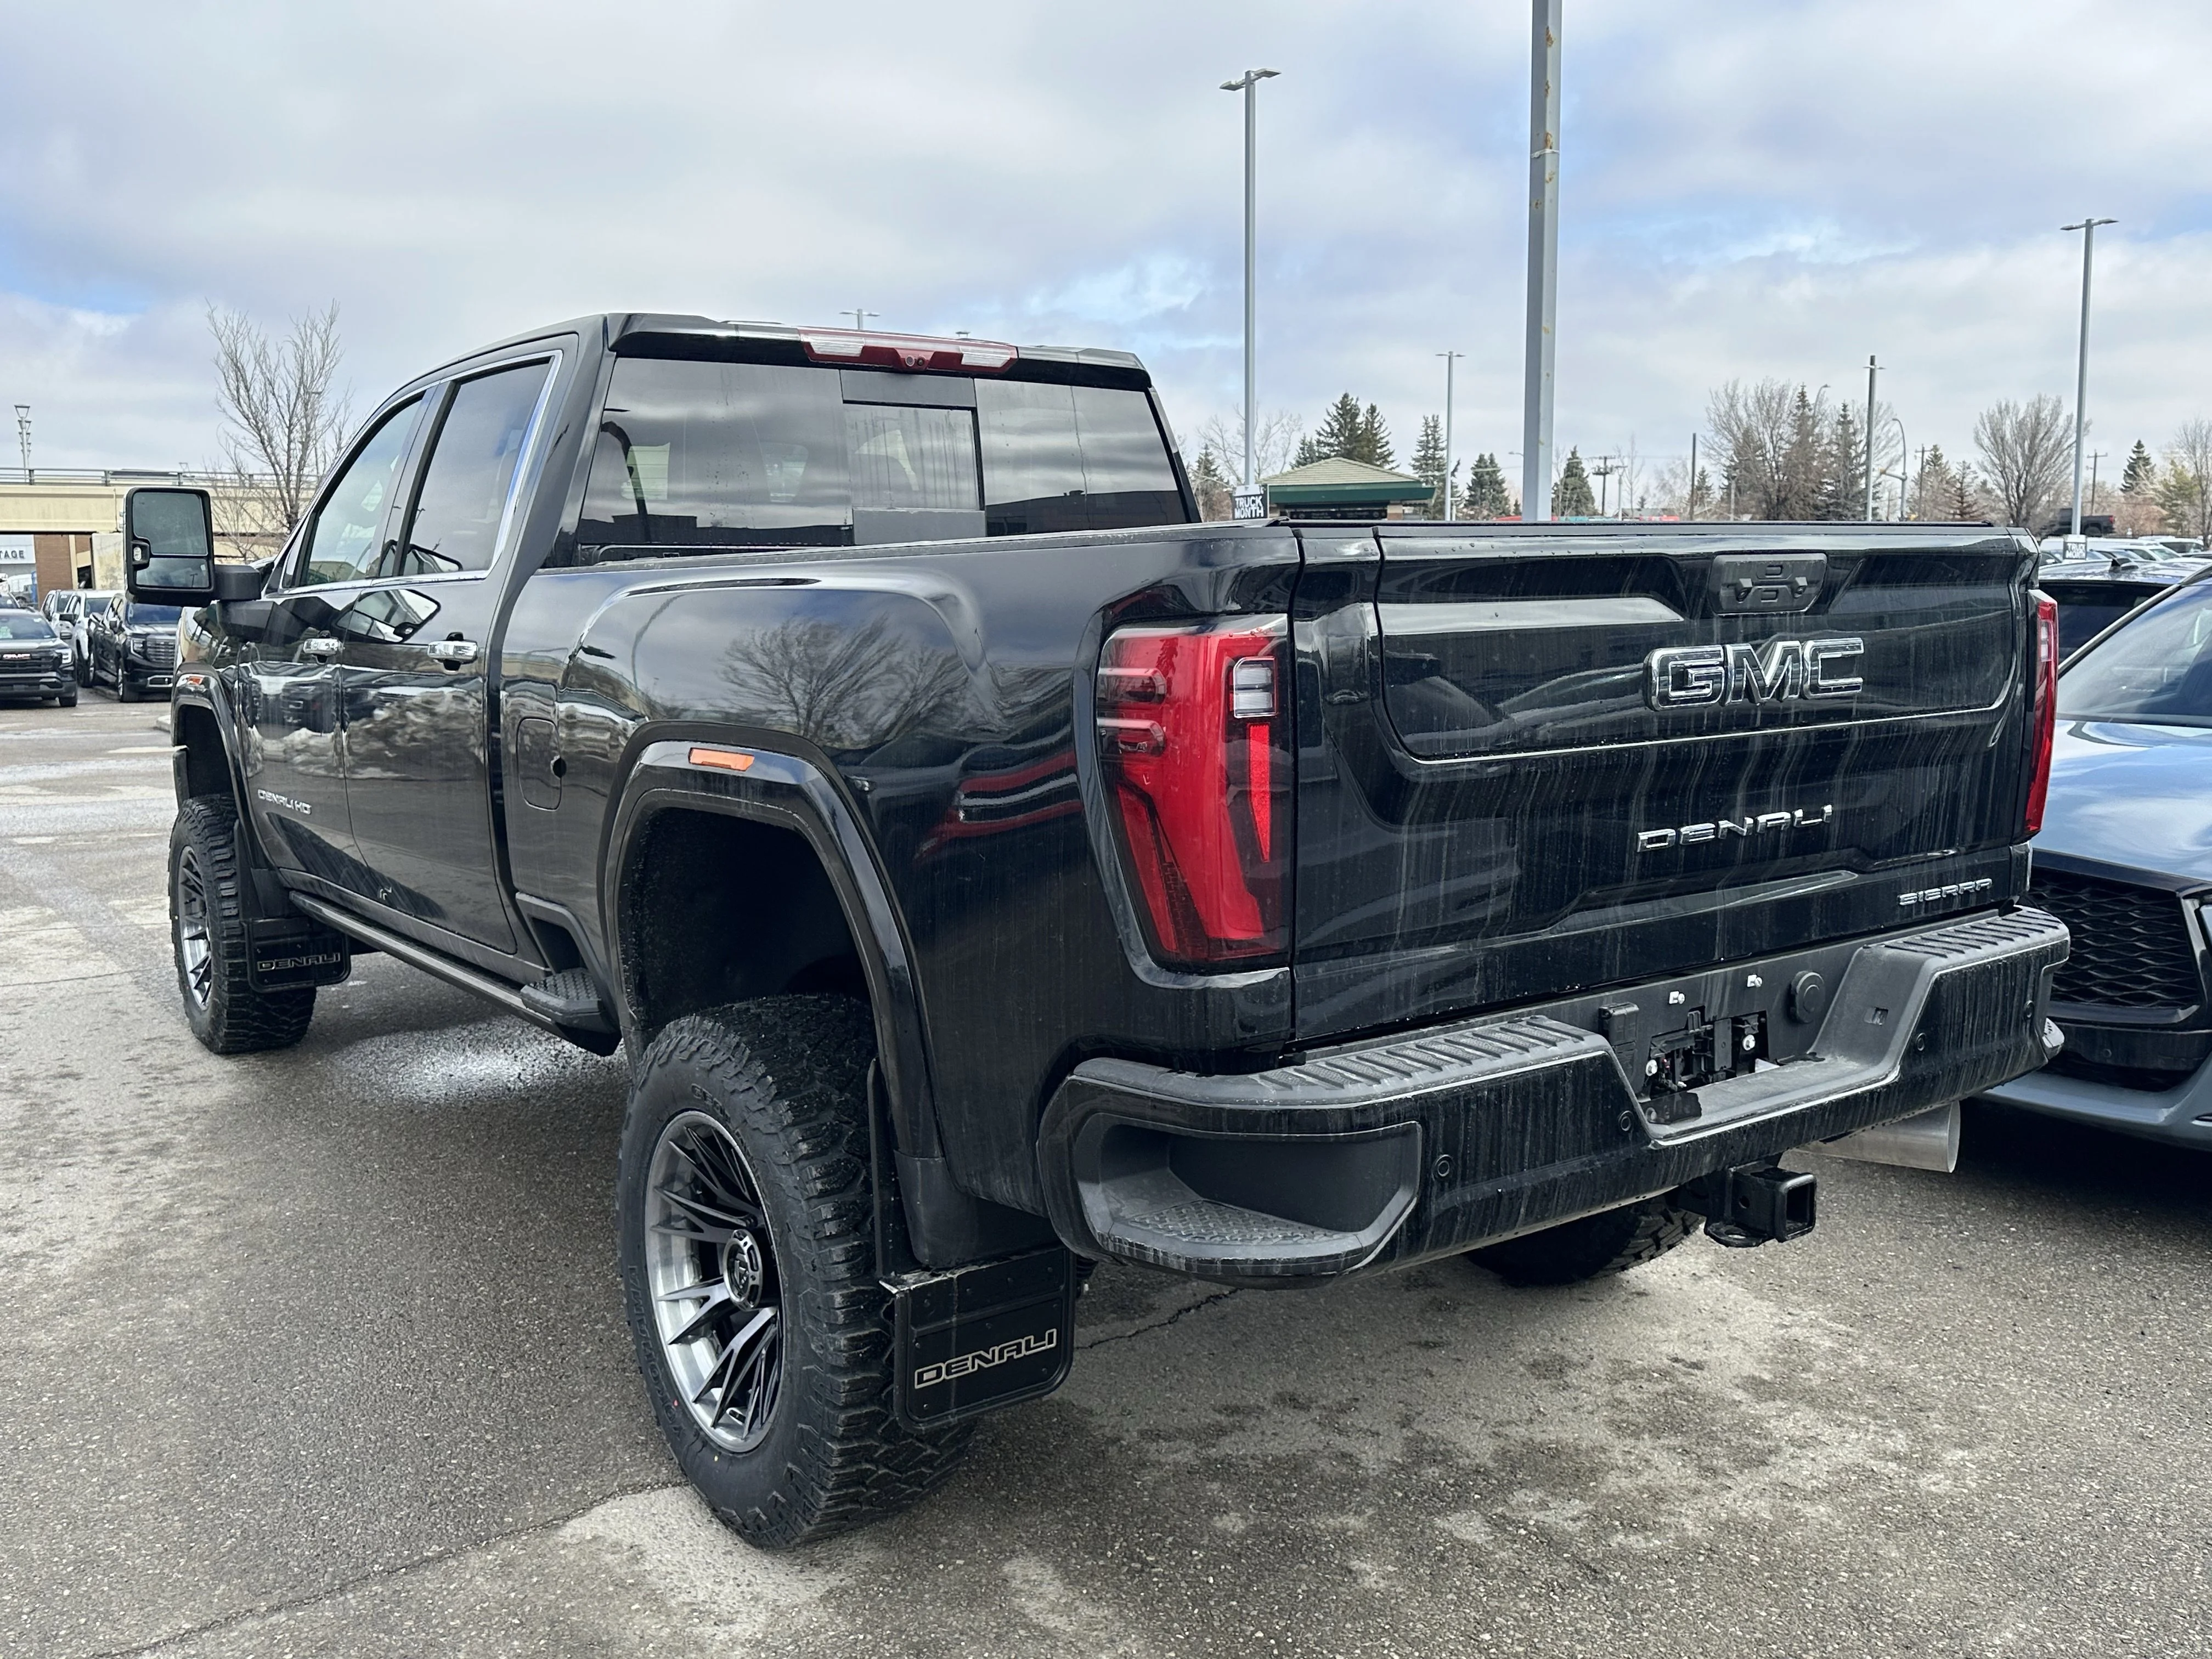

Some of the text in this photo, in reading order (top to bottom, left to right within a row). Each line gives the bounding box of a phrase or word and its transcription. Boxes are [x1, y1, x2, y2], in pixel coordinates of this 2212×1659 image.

[1234, 506, 1264, 519] MONTH
[1235, 495, 1262, 509] TRUCK
[1644, 637, 1865, 712] GMC
[257, 788, 312, 815] DENALI HD
[1637, 803, 1833, 853] DENALI
[1897, 878, 1993, 906] SIERRA
[257, 952, 340, 972] DENALI
[628, 1265, 684, 1442] YOKOHAMA
[914, 1328, 1057, 1390] DENALI
